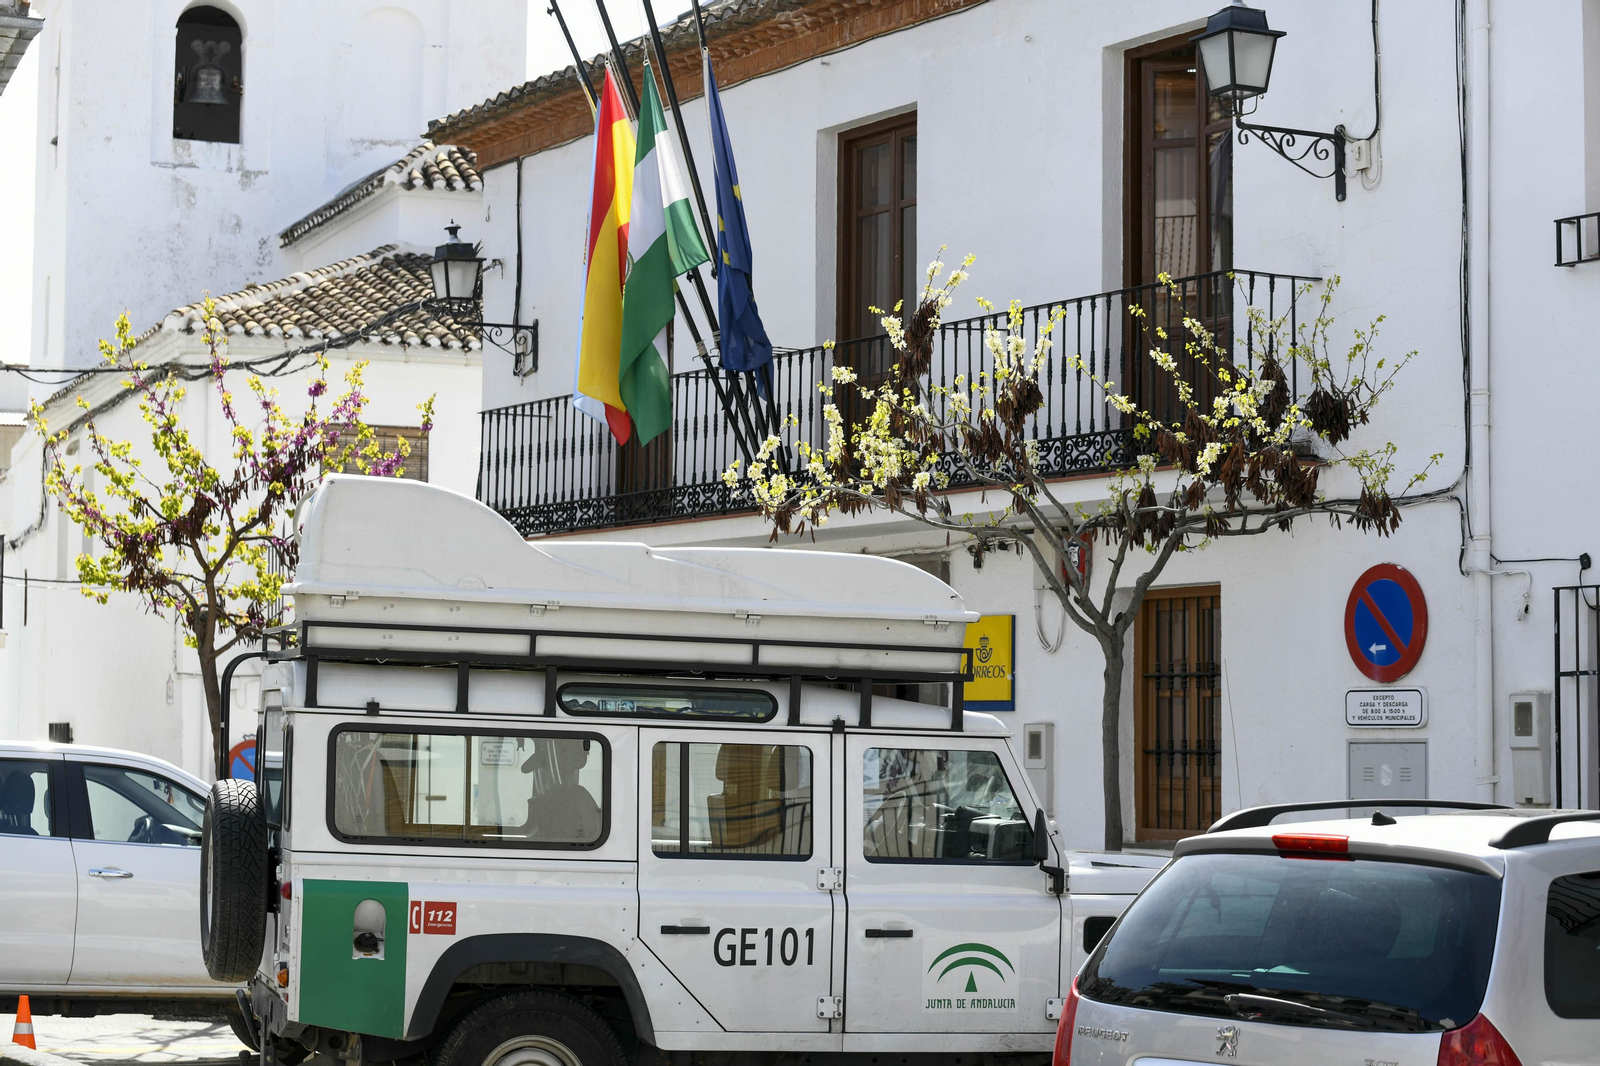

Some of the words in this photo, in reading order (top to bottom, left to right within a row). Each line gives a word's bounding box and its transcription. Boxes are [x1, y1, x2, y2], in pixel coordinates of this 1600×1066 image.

[428, 910, 453, 922] 112
[713, 927, 814, 967] GE101
[925, 998, 952, 1009] JUNTA
[956, 998, 966, 1009] DE
[970, 998, 1016, 1009] ANDALUCIA
[1077, 1025, 1130, 1042] PEUGEOT
